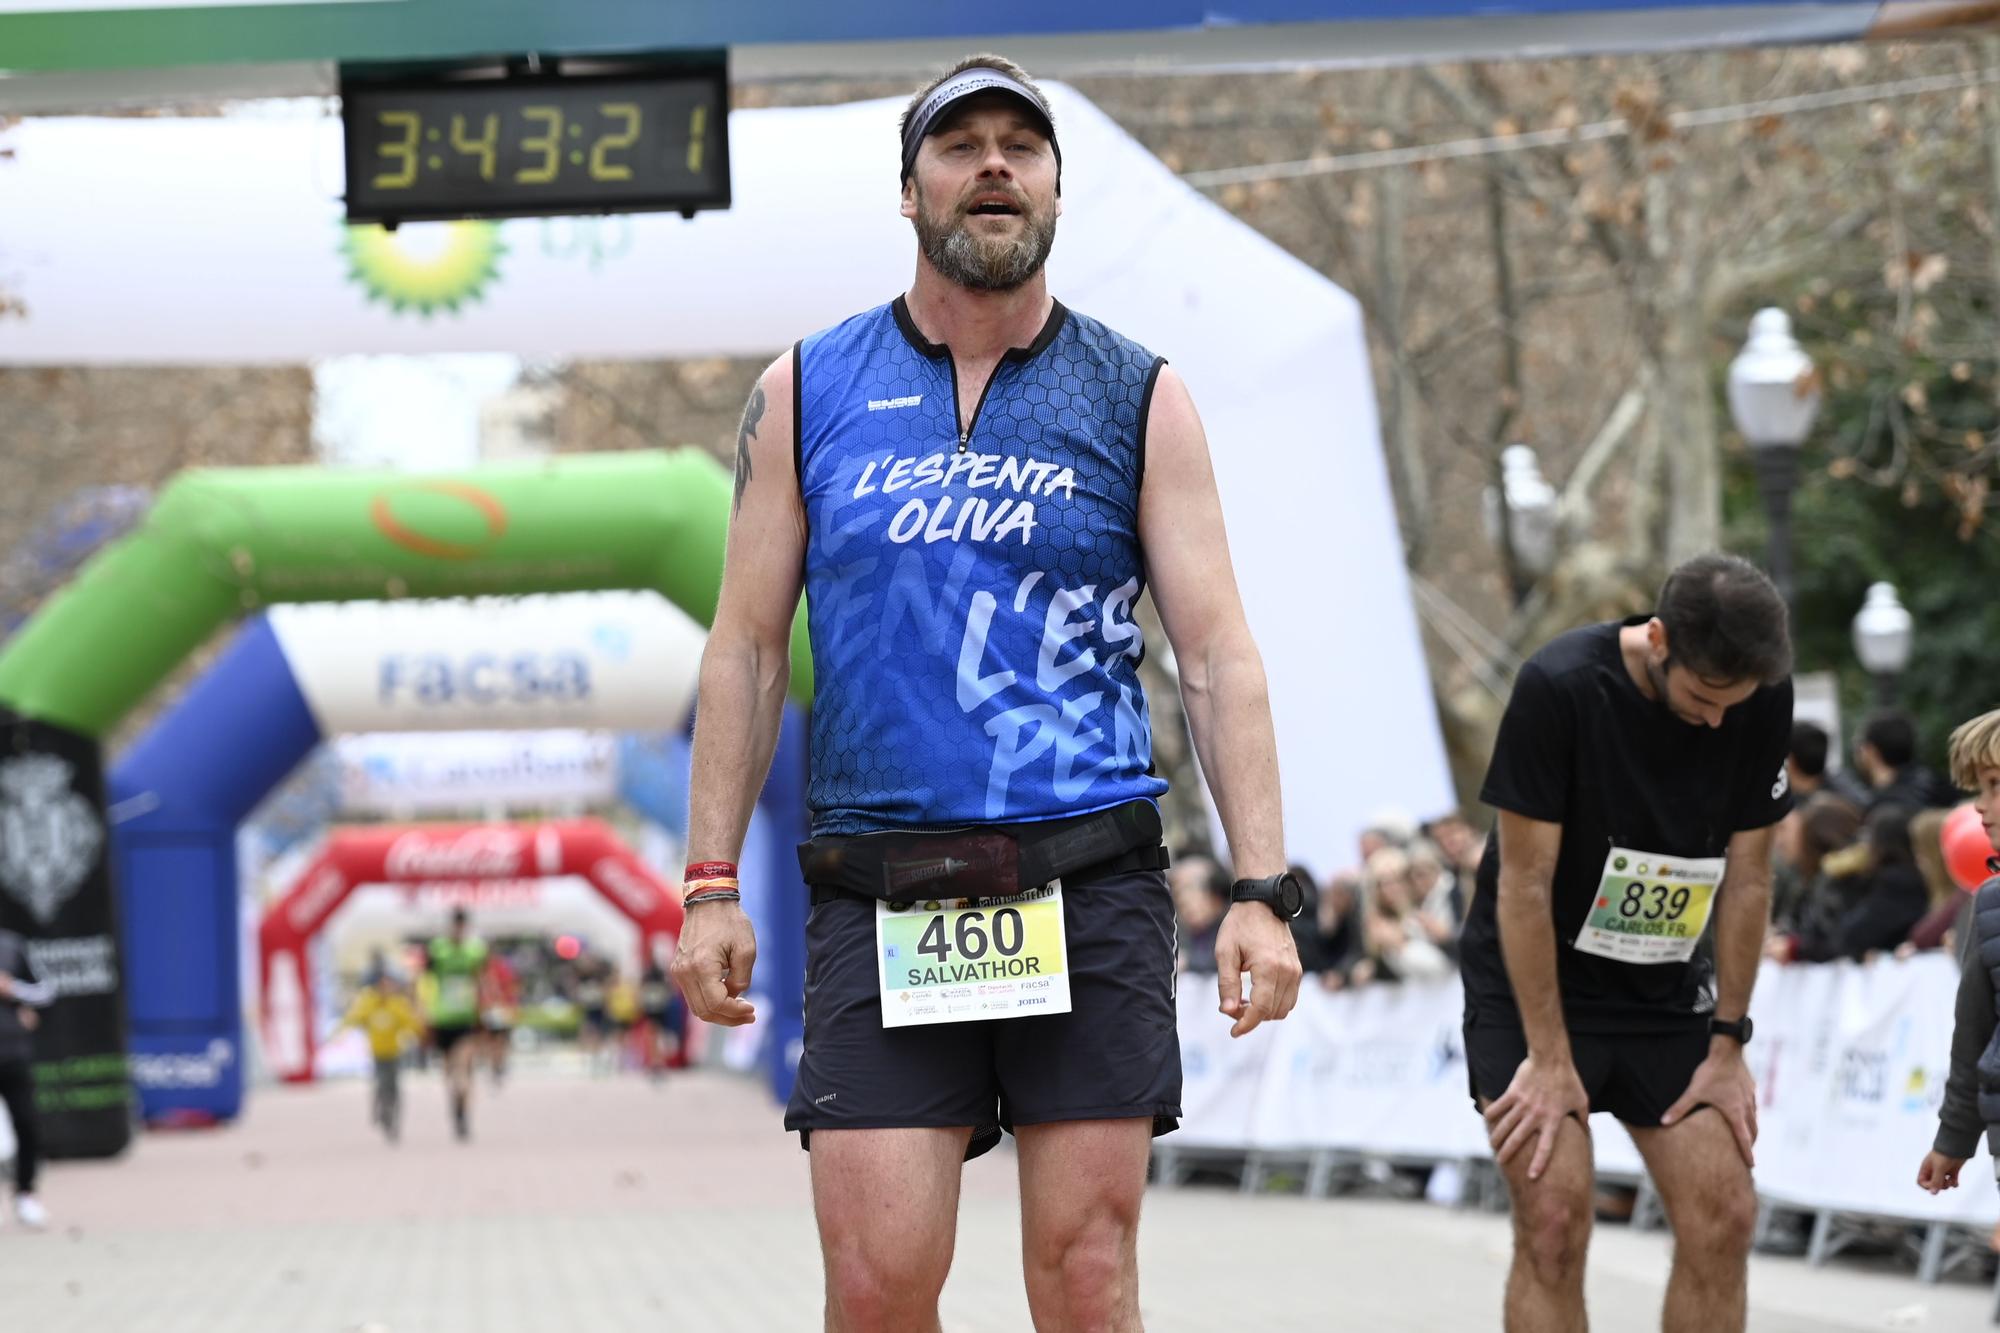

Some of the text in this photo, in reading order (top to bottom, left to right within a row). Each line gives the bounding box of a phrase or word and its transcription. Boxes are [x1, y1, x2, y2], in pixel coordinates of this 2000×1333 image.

[853, 452, 1077, 500] L'ESPENTA
[887, 495, 1038, 545] OLIVA
[1619, 881, 1690, 920] 839
[917, 907, 1024, 963] 460
[1604, 917, 1687, 937] CARLOS FR
[907, 956, 1041, 986] SALVATHOR
